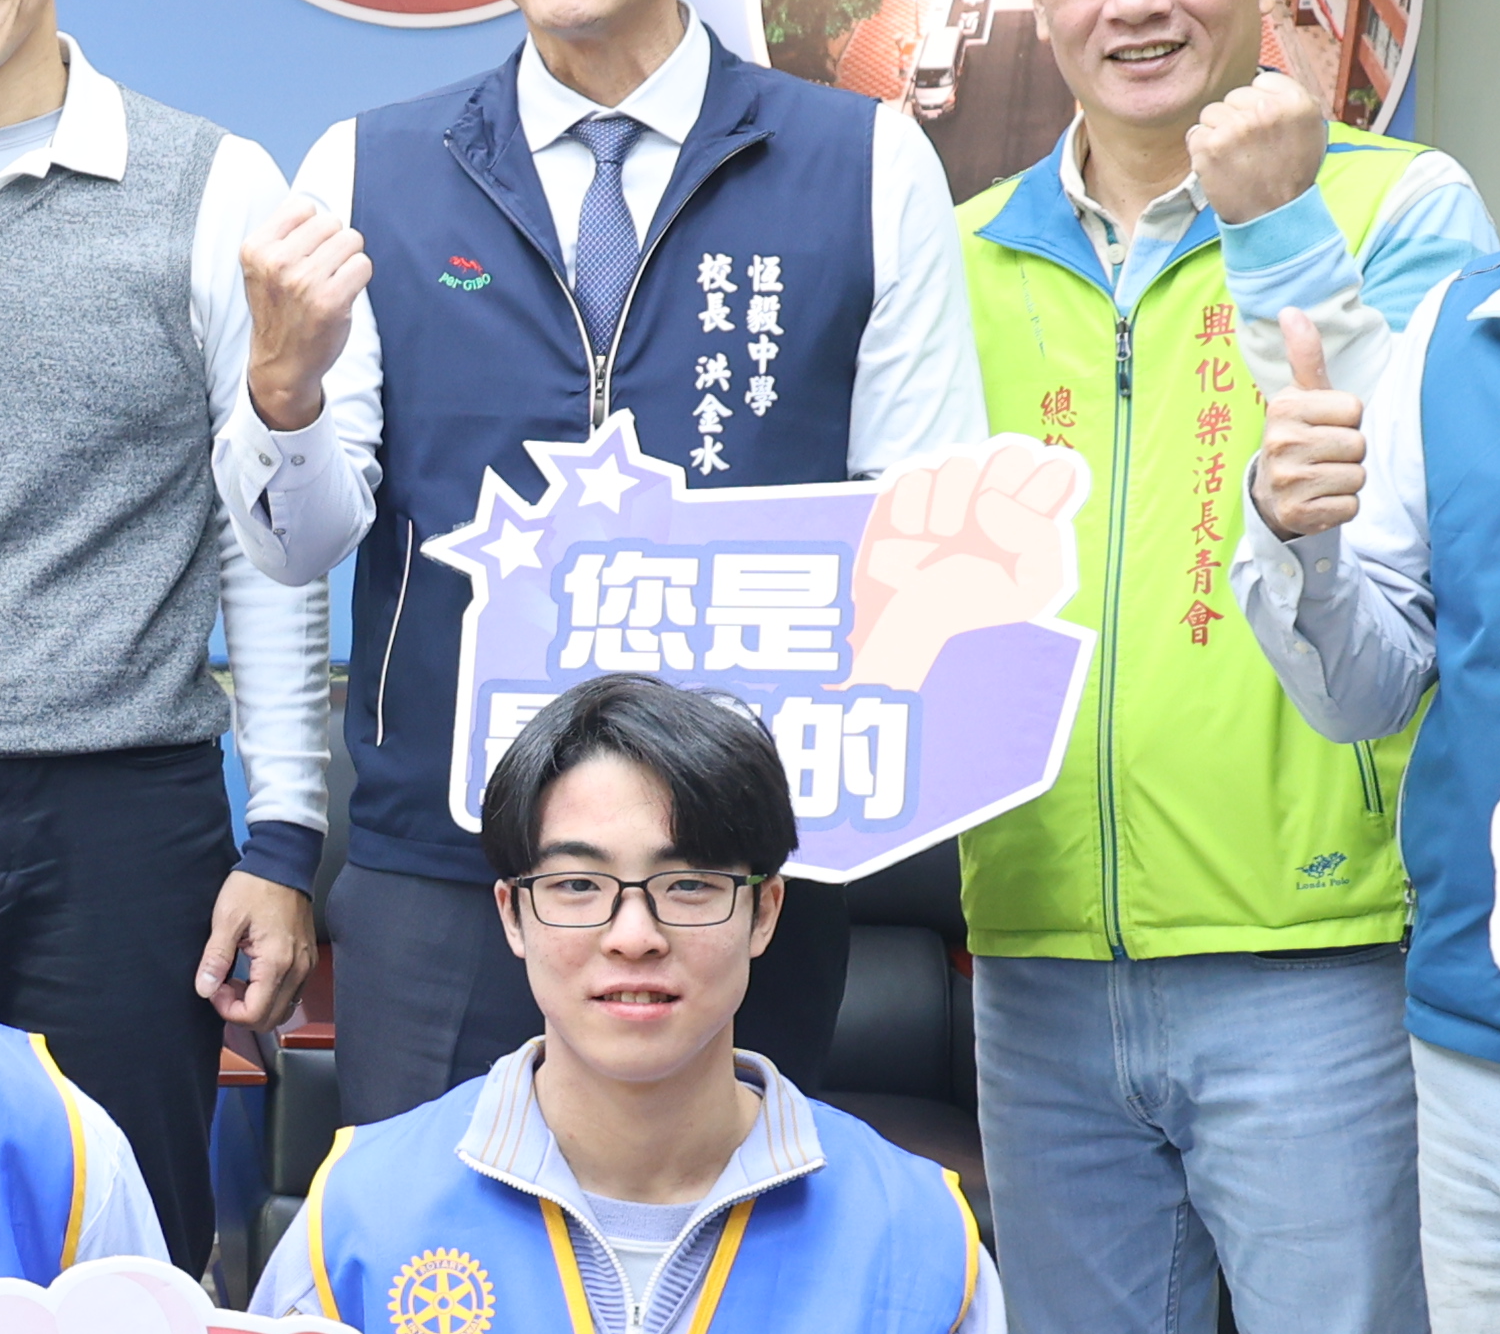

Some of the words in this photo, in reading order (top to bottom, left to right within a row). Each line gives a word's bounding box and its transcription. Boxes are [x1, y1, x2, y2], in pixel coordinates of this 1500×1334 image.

[696, 252, 738, 334] 校長
[689, 352, 734, 477] 洪金水
[1178, 303, 1237, 647] 興化樂活長青會
[560, 550, 841, 672] 您是
[417, 1259, 465, 1275] ROTARY
